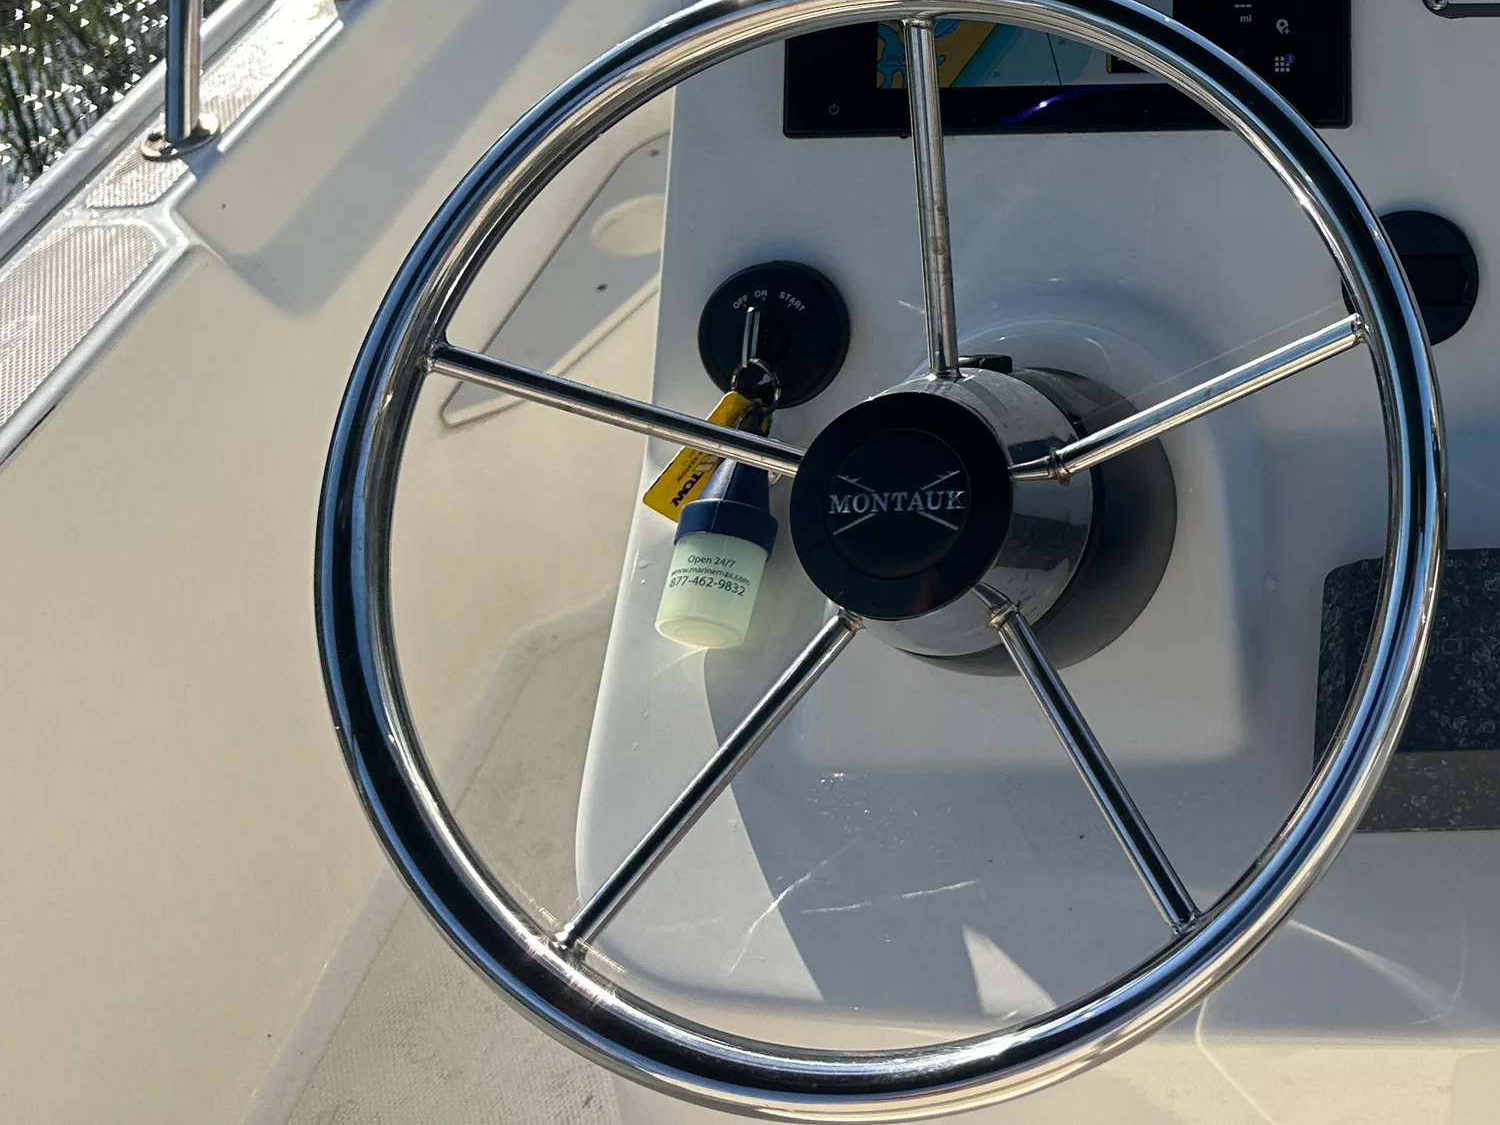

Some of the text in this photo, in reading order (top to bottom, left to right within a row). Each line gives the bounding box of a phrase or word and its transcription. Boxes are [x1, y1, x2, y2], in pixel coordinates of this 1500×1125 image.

[732, 289, 806, 311] OFF ON START
[672, 472, 705, 507] TOW
[829, 489, 966, 515] MONTAUK
[688, 555, 736, 567] Open 24/7
[670, 576, 746, 597] 877-462-9832
[672, 567, 750, 586] www.marinemax.com
